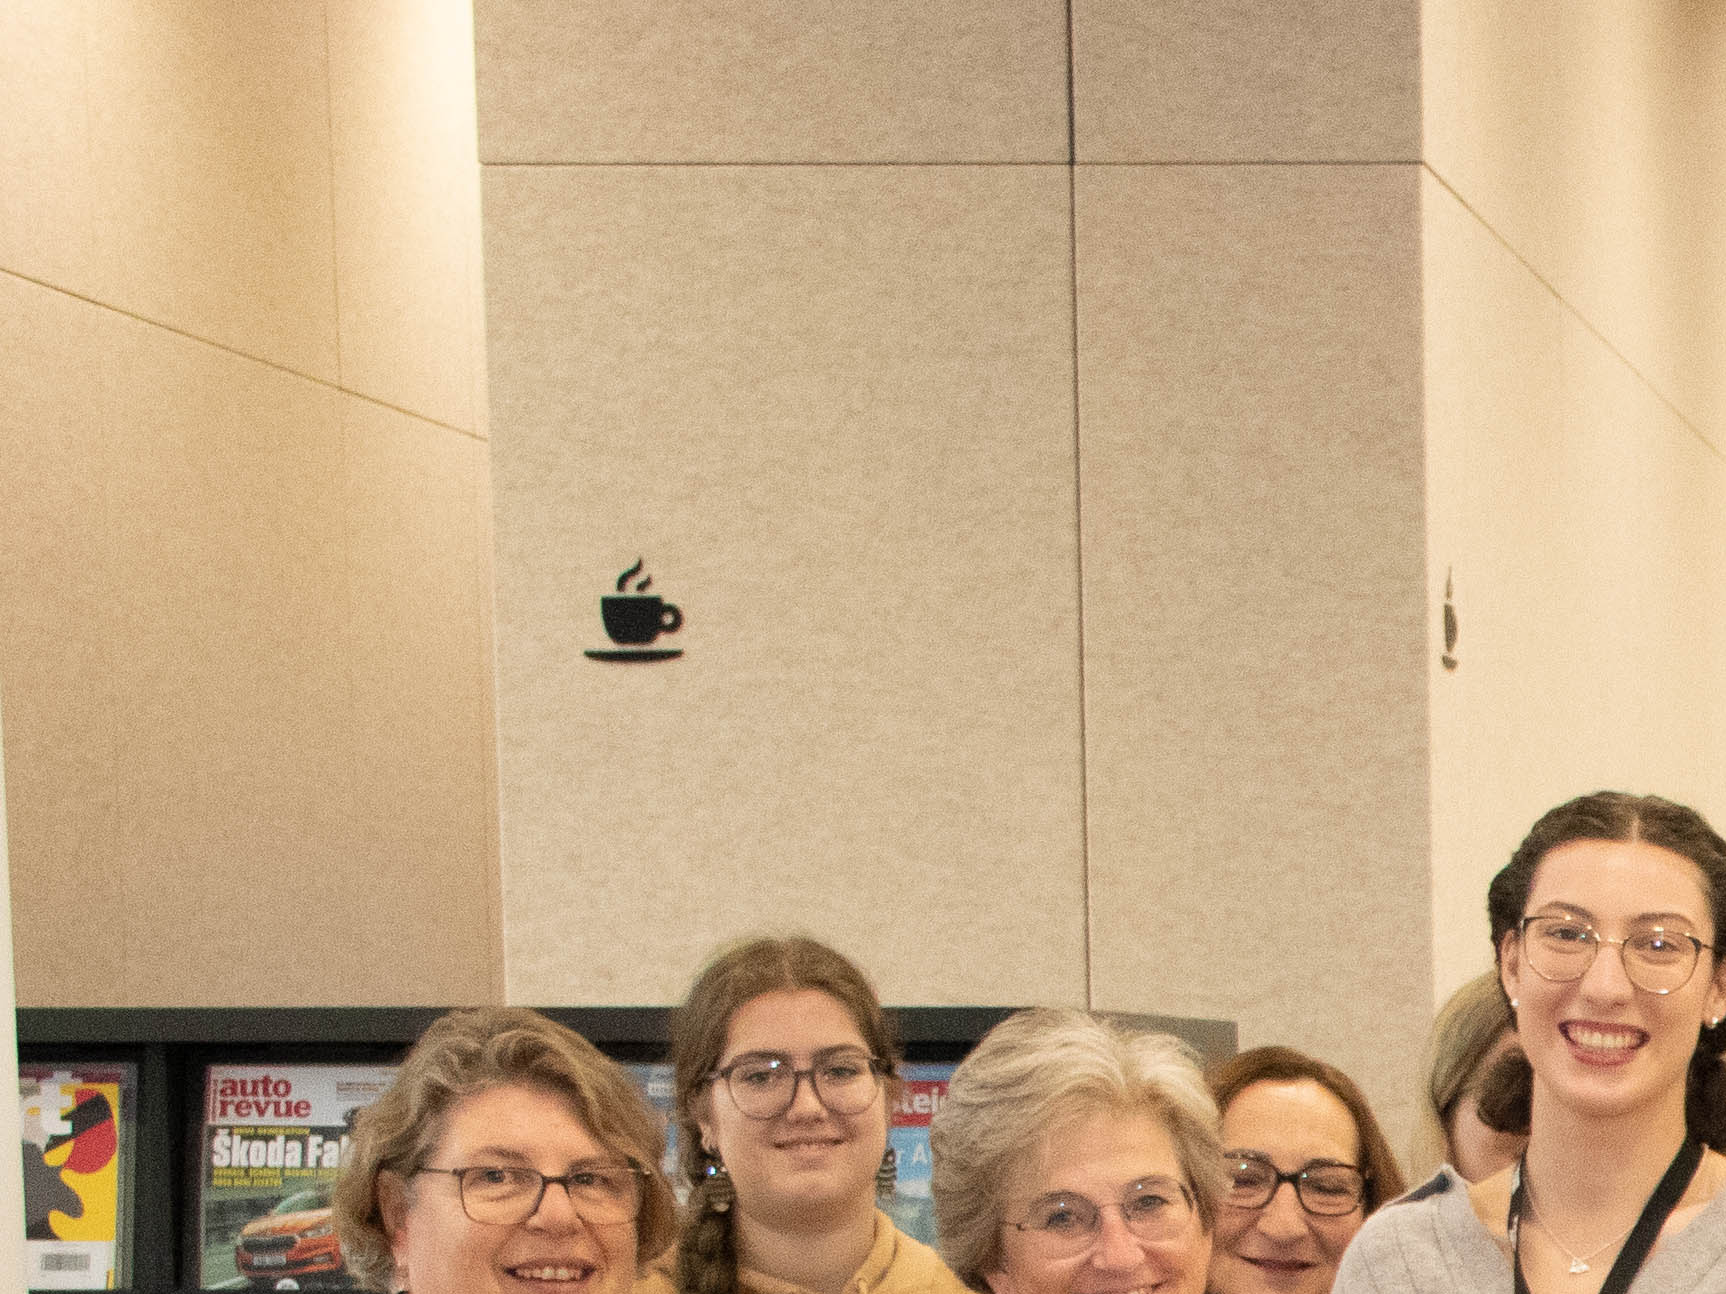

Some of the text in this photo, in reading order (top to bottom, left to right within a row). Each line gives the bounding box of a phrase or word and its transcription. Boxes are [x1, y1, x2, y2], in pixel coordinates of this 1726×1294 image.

[220, 1076, 292, 1098] auto
[219, 1099, 312, 1118] revue
[212, 1128, 302, 1168] Škoda
